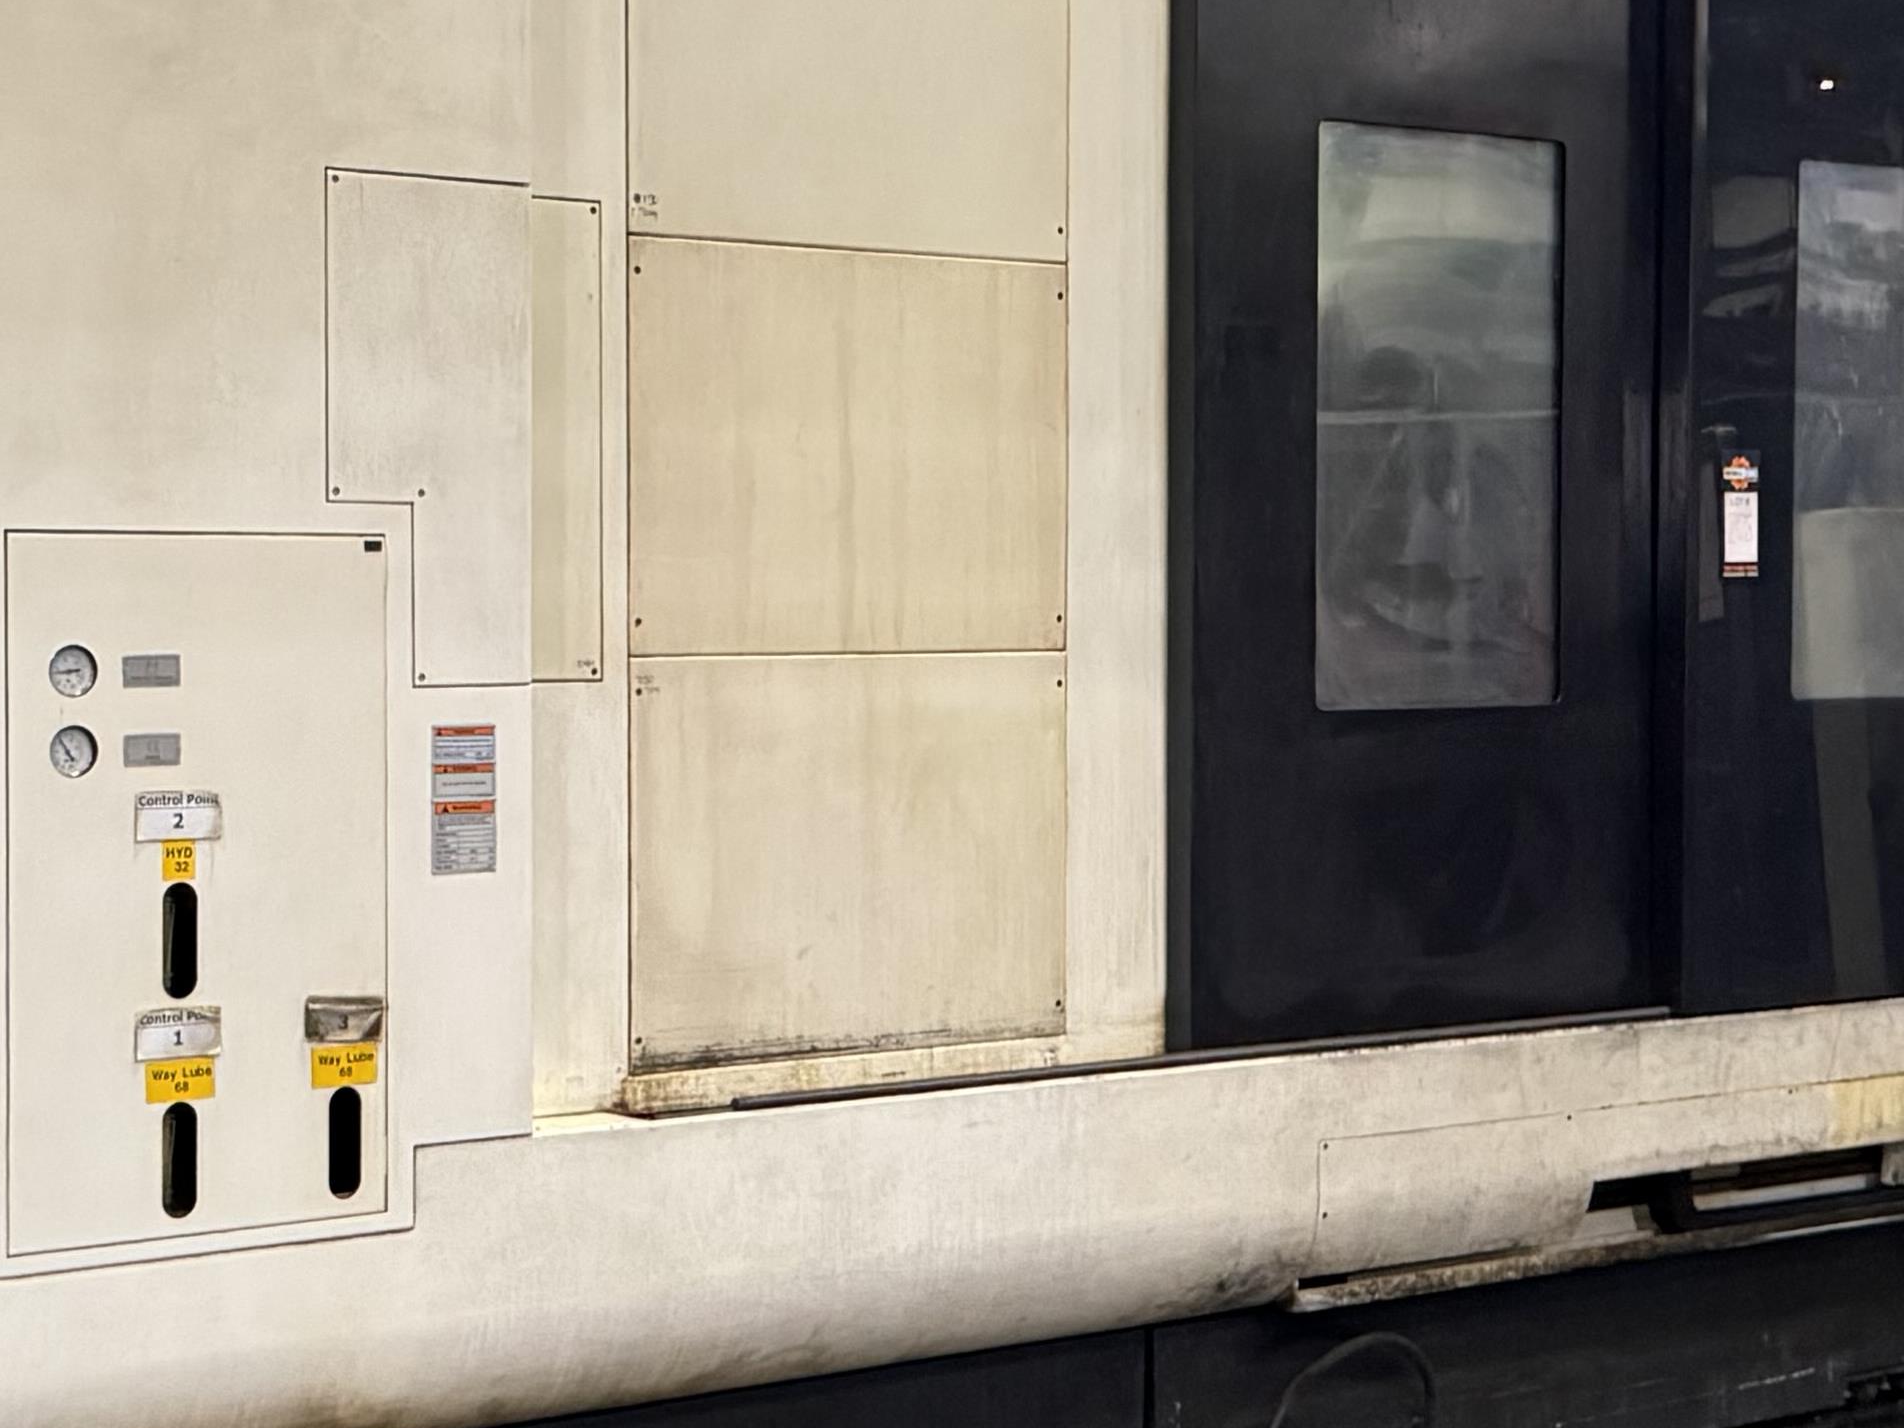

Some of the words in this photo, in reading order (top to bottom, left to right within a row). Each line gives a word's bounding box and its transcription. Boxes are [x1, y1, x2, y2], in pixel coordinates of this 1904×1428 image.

[138, 793, 183, 807] Control
[173, 812, 184, 829] 2
[165, 846, 193, 859] HYD
[174, 861, 190, 872] 32
[140, 1009, 184, 1025] Control
[338, 1014, 349, 1030] 3
[173, 1030, 184, 1046] 1
[318, 1054, 341, 1066] Way
[346, 1052, 375, 1064] Lube
[151, 1069, 177, 1082] Way
[182, 1065, 213, 1078] Lube
[339, 1066, 353, 1077] 68
[174, 1081, 190, 1093] 68
